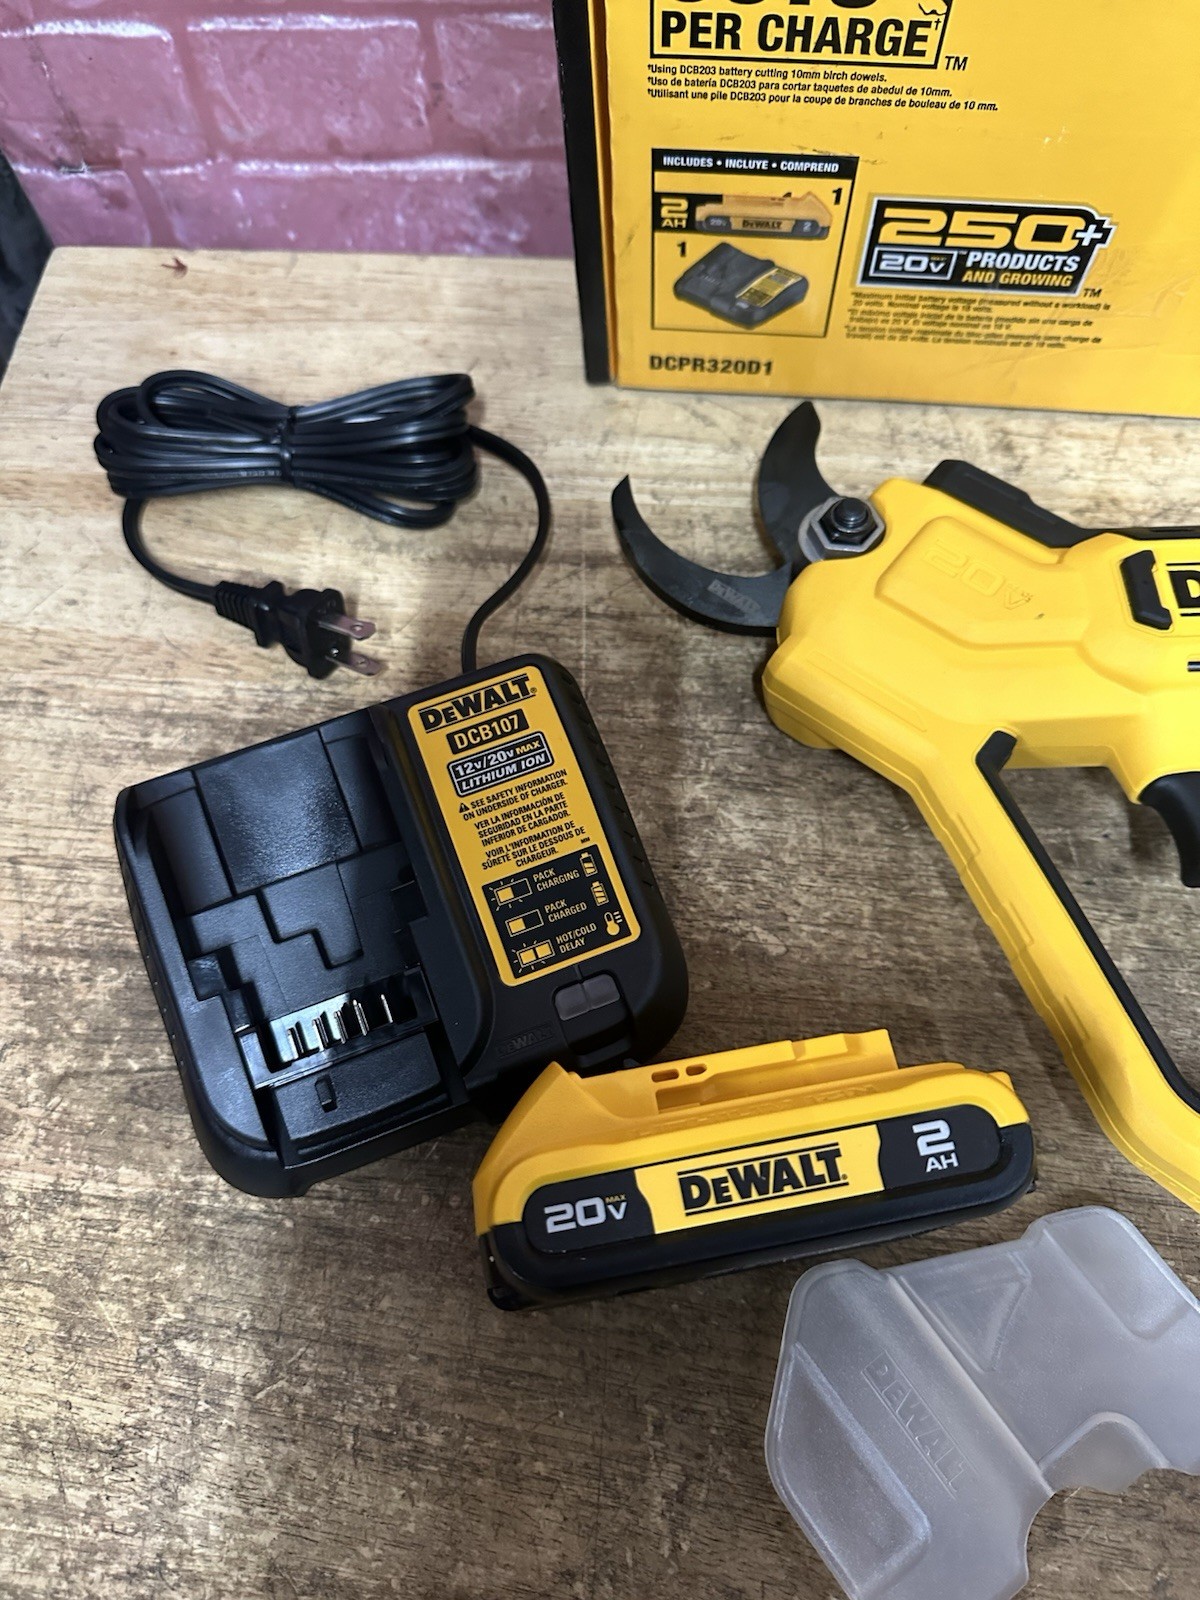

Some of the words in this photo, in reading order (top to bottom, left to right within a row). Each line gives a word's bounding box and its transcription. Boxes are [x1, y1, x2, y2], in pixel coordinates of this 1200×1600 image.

[662, 11, 741, 50] PER
[680, 65, 716, 75] DCB203
[719, 66, 752, 78] battery
[755, 68, 788, 79] cutting
[792, 70, 820, 79] 10mm
[823, 71, 847, 81] birch
[850, 72, 887, 82] dowels.
[671, 78, 682, 86] de
[685, 78, 717, 88] batería
[720, 79, 756, 88] DCB203
[759, 82, 780, 91] para
[782, 82, 811, 91] cortar
[814, 83, 854, 94] taquetes
[857, 84, 868, 93] de
[871, 85, 903, 95] abedul
[906, 87, 917, 96] de
[920, 87, 952, 97] 10mm.
[691, 91, 708, 99] une
[711, 91, 728, 101] pile
[730, 92, 766, 101] DCB203
[769, 94, 790, 104] pour
[793, 94, 801, 103] la
[804, 96, 832, 105] coupe
[835, 96, 846, 105] de
[850, 97, 892, 107] branches
[895, 99, 906, 108] de
[909, 100, 946, 109] bouleau
[950, 101, 960, 110] de
[964, 101, 974, 110] 10
[977, 102, 998, 111] mm.
[663, 156, 713, 168] INCLUDES
[725, 158, 769, 170] INCLUYE
[780, 160, 839, 173] COMPREND
[660, 198, 688, 219] 2
[832, 187, 843, 205] 1
[661, 219, 687, 228] AH
[677, 242, 686, 257] 1
[965, 251, 1081, 273] PRODUCTS
[962, 270, 996, 284] AND
[999, 272, 1073, 287] GROWING
[650, 355, 773, 375] DCPR320D1
[454, 714, 520, 749] DCB107
[516, 740, 541, 755] MAX
[461, 762, 517, 790] LITHIUM
[521, 753, 546, 769] ION
[463, 811, 475, 821] ON
[476, 795, 519, 817] UNDERSIDE
[520, 791, 530, 801] OF
[531, 779, 568, 796] CHARGER.
[470, 799, 485, 809] SEE
[486, 788, 513, 804] SAFETY
[514, 769, 567, 792] INFORMATION
[474, 819, 490, 830] VER
[490, 814, 501, 825] LA
[501, 797, 554, 820] INFORMACIÓN
[554, 792, 566, 802] DE
[478, 819, 521, 839] SEGURIDAD
[521, 814, 533, 824] EN
[534, 810, 544, 820] LA
[544, 800, 568, 815] PARTE
[481, 829, 516, 847] INFERIOR
[517, 825, 528, 835] DE
[528, 809, 571, 831] CARGADOR.
[485, 846, 505, 859] VOIR
[505, 824, 564, 852] L'INFORMATION
[564, 820, 576, 830] DE
[512, 848, 529, 860] SUR
[529, 844, 539, 854] LE
[538, 829, 574, 850] DESSOUS
[574, 826, 586, 836] DE
[515, 846, 558, 868] CHARGEUR.
[533, 868, 556, 883] PACK
[536, 869, 580, 892] CHARGING
[544, 899, 567, 914] PACK
[548, 902, 587, 923] CHARGED
[555, 922, 597, 945] HOT/COLD
[559, 937, 586, 954] DELAY
[912, 1120, 955, 1156] 2
[926, 1152, 959, 1172] AH
